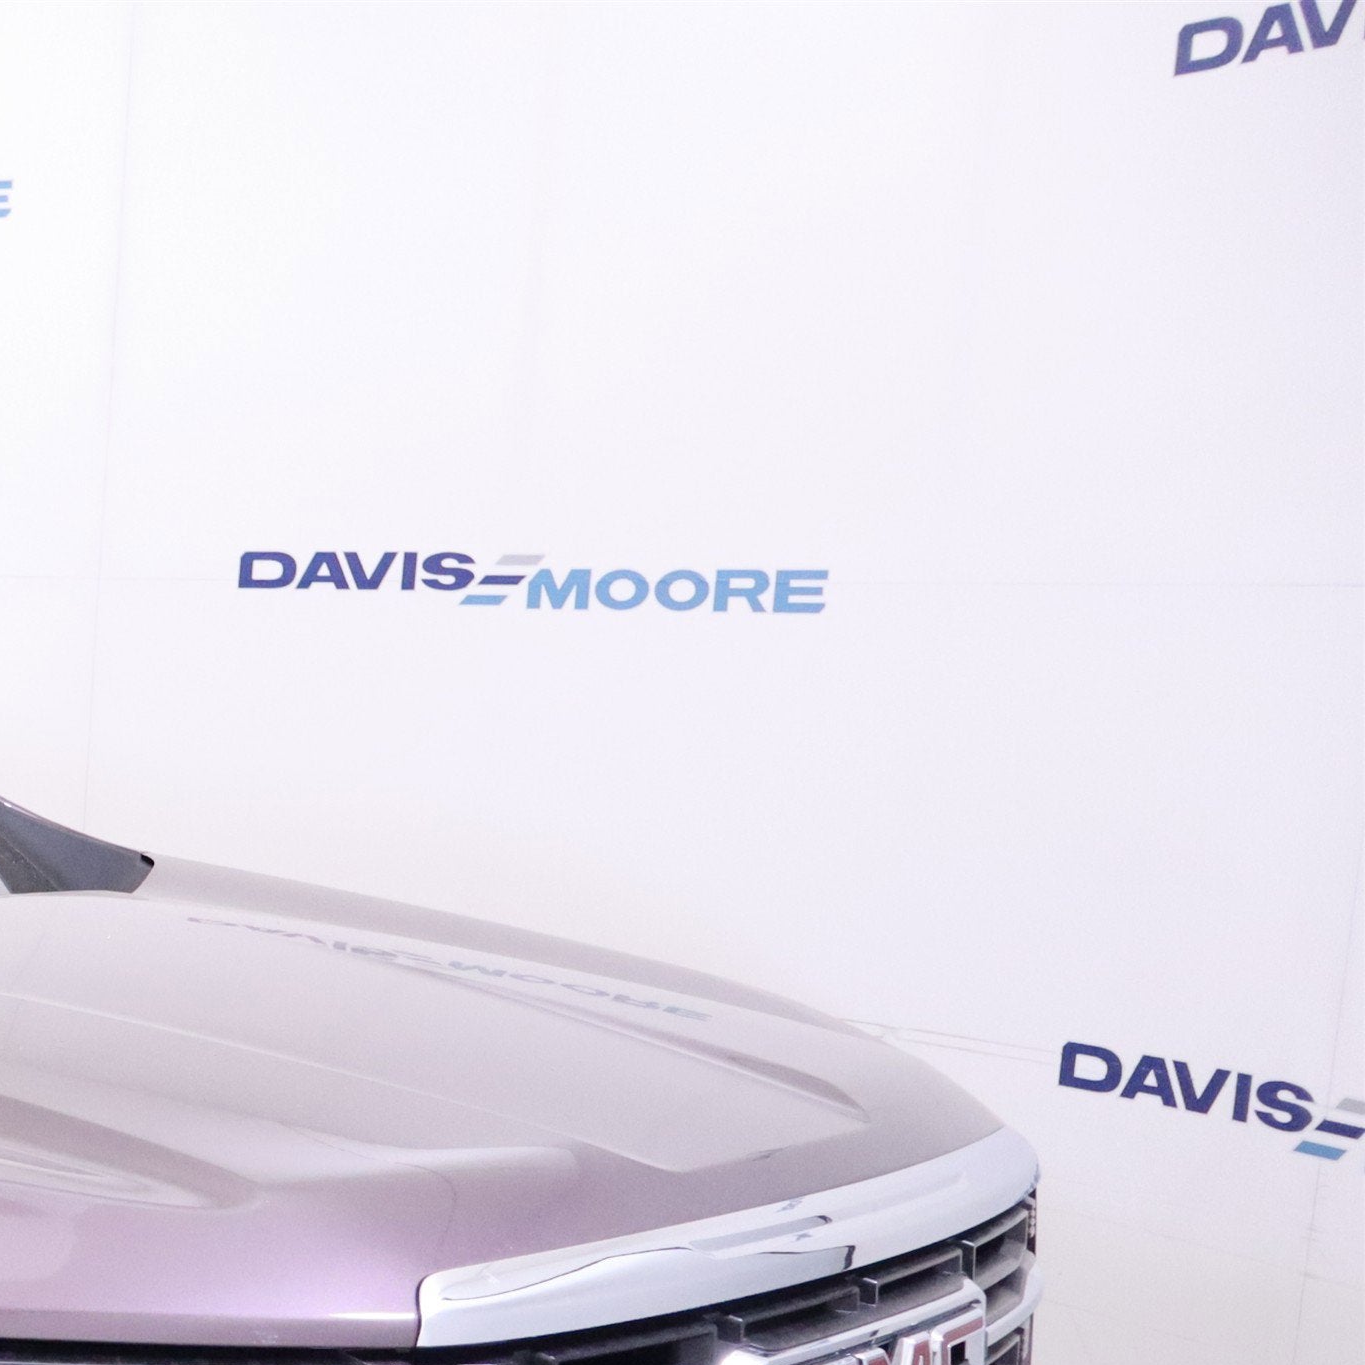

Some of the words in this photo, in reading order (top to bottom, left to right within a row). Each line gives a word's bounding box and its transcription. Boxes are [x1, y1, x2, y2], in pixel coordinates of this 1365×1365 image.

[1174, 0, 1365, 76] DAV
[237, 552, 475, 590] DAVIS
[525, 568, 829, 613] MOORE
[1057, 1041, 1314, 1132] DAVIS
